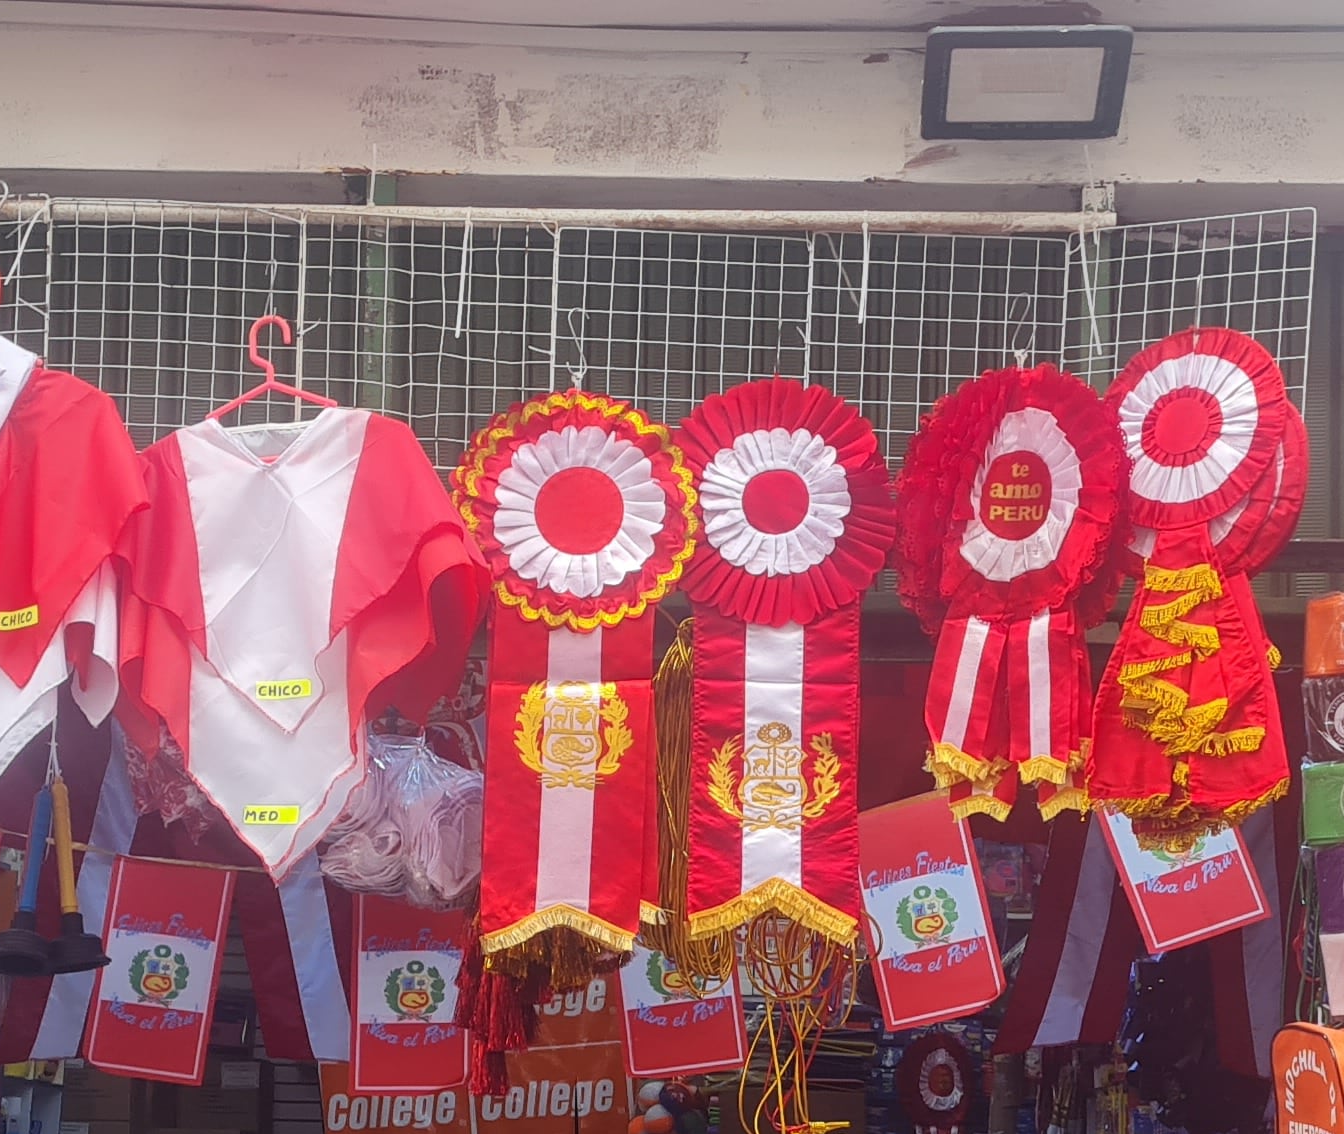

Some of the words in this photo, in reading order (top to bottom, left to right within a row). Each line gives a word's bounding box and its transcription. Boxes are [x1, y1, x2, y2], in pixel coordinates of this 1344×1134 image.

[1011, 462, 1029, 478] te
[989, 482, 1042, 499] amo
[989, 504, 1044, 521] PERU
[0, 612, 34, 627] CHICO
[258, 684, 302, 697] CHICO
[244, 809, 279, 821] MED
[867, 865, 912, 898] Felices
[916, 851, 966, 877] Fiestas
[1183, 873, 1198, 891] el
[927, 954, 942, 972] el
[672, 1011, 688, 1027] el
[1285, 1048, 1328, 1116] MOCHILA
[481, 1077, 614, 1122] College
[326, 1090, 457, 1131] College
